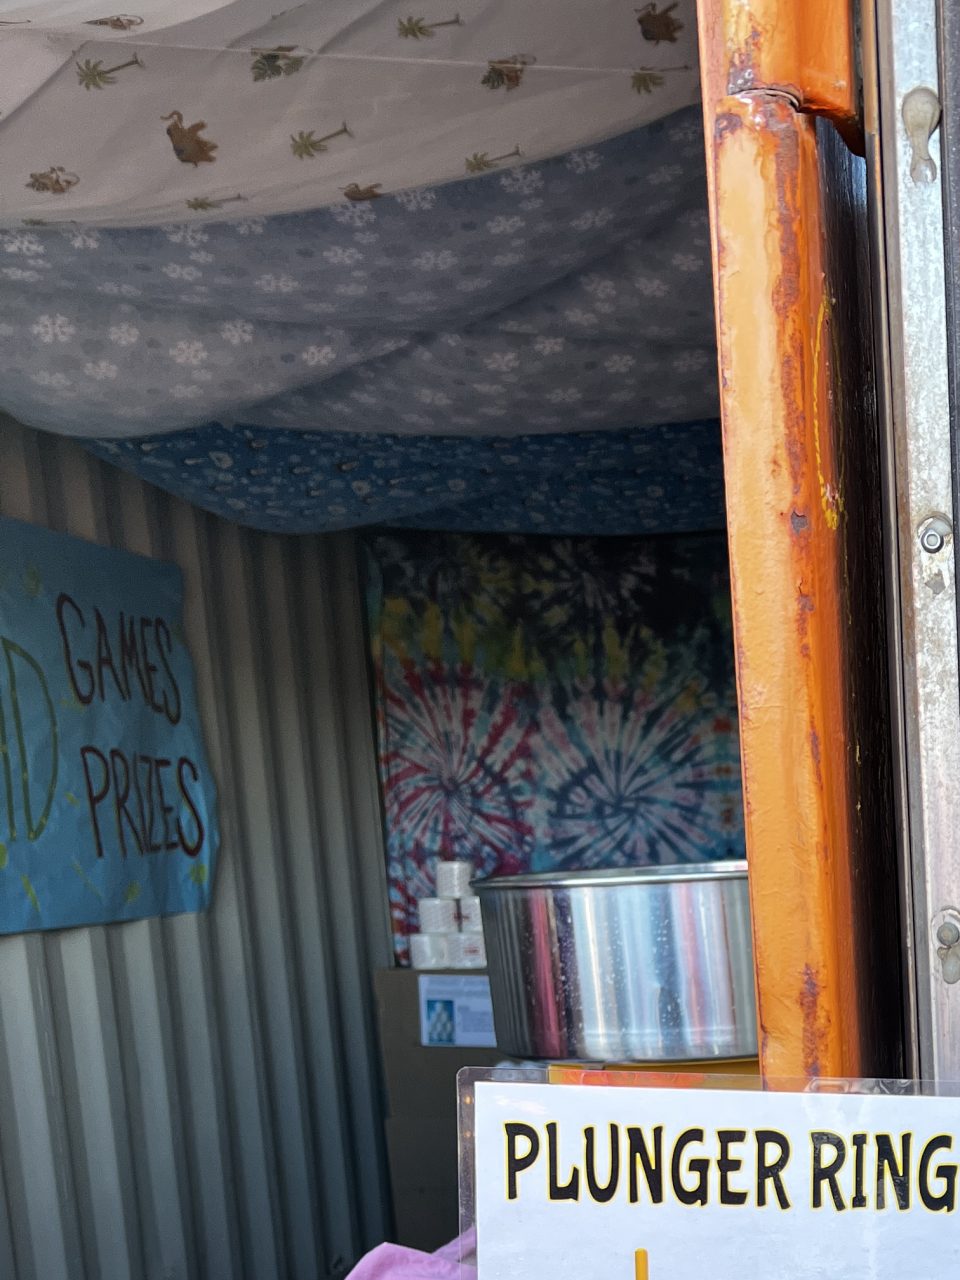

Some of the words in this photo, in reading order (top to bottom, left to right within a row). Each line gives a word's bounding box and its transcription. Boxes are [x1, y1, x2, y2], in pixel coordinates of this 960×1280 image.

[55, 592, 182, 726] GAMES
[80, 744, 206, 859] PRIZES
[503, 1121, 792, 1211] PLUNGER
[809, 1130, 959, 1214] RING
